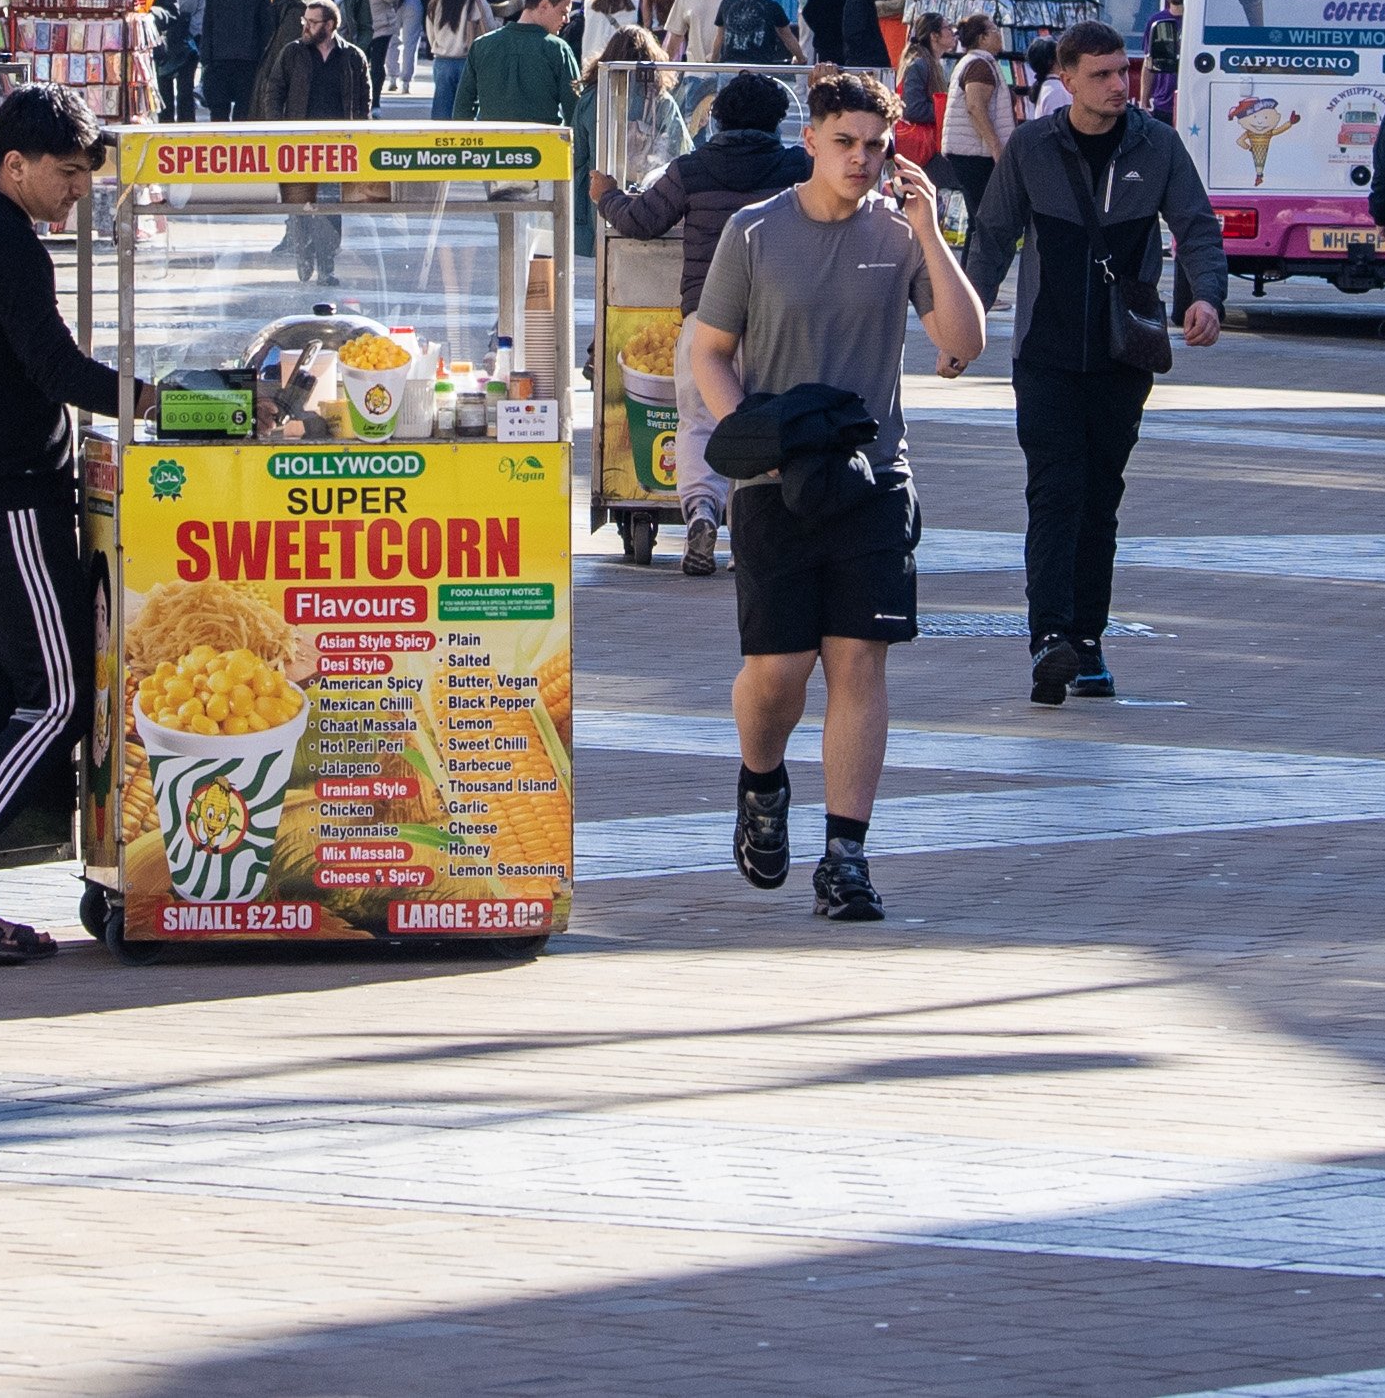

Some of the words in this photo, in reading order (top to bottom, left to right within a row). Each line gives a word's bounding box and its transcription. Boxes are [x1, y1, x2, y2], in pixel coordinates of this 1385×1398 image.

[1289, 30, 1354, 45] WHITBY
[1228, 55, 1351, 69] CAPPUCCINO
[1338, 87, 1373, 99] WHIPPY
[434, 138, 456, 147] EST.
[460, 137, 484, 147] 2016
[157, 144, 270, 174] SPECIAL
[277, 143, 359, 173] OFFER
[380, 151, 412, 170] Buy
[416, 150, 457, 166] More
[461, 151, 491, 169] Pay
[495, 150, 533, 165] Less
[165, 393, 188, 401] FOOD
[505, 405, 520, 413] VISA
[646, 410, 671, 419] SUPER
[274, 455, 420, 476] HOLLYWOOD
[499, 457, 545, 482] Vegan
[287, 486, 408, 515] SUPER
[176, 517, 520, 582] SWEETCORN
[450, 589, 473, 597] FOOD
[474, 588, 511, 597] ALLERGY
[512, 587, 544, 596] NOTICE:
[295, 592, 416, 618] Flavours
[319, 636, 356, 649] Asian
[359, 636, 392, 651] Style
[395, 635, 431, 650] Spicy
[448, 633, 481, 646] Plain
[321, 659, 349, 671] Desi
[352, 659, 386, 674] Style
[448, 654, 490, 667] Salted
[319, 678, 383, 690] American
[387, 677, 423, 691] Spicy
[448, 675, 493, 690] Butter,
[497, 675, 538, 690] Vegan
[320, 698, 375, 711] Mexican
[380, 697, 413, 710] Chilli
[448, 696, 485, 709] Black
[490, 696, 536, 711] Pepper
[320, 719, 359, 732] Chaat
[363, 719, 417, 732] Massala
[448, 718, 493, 730] Lemon
[320, 740, 343, 753] Hot
[347, 740, 373, 752] Peri
[378, 740, 404, 752] Peri
[448, 738, 491, 751] Sweet
[494, 737, 527, 751] Chilli
[320, 762, 381, 776] Jalapeno
[448, 759, 512, 772] Barbecue
[322, 784, 370, 797] Iranian
[373, 783, 408, 799] Style
[448, 779, 513, 792] Thousand
[517, 778, 557, 792] Island
[320, 804, 374, 817] Chicken
[448, 801, 489, 814] Garlic
[320, 825, 399, 839] Mayonnaise
[448, 822, 498, 835] Cheese
[322, 847, 347, 860] Mix
[350, 847, 405, 860] Massala
[448, 843, 491, 858] Honey
[320, 871, 370, 884] Cheese
[388, 870, 425, 885] Spicy
[448, 864, 493, 876] Lemon
[497, 863, 566, 878] Seasoning
[162, 906, 242, 931] SMALL:
[246, 905, 312, 930] £2.50
[397, 904, 473, 929] LARGE:
[478, 902, 544, 928] £3.00
